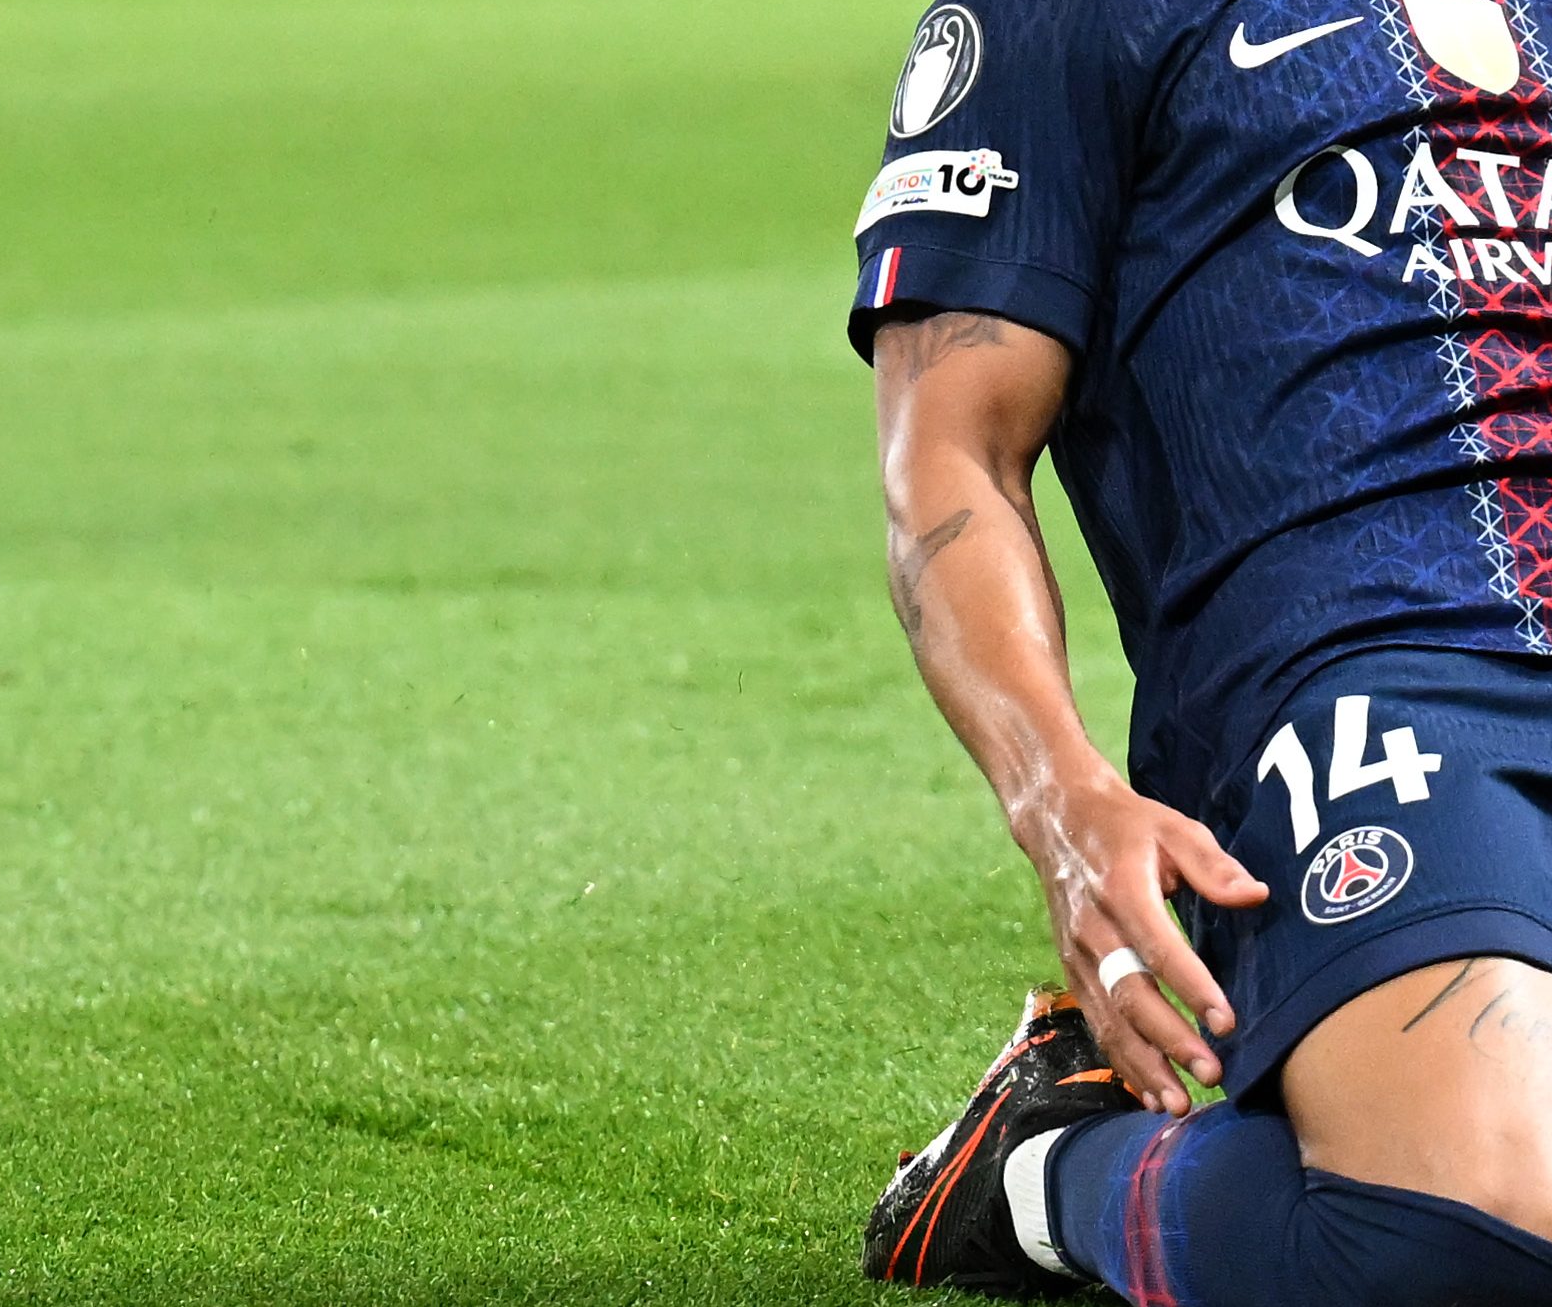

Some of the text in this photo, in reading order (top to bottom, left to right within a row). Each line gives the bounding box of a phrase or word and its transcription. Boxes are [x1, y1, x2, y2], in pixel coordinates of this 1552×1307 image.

[937, 164, 986, 196] 10
[1257, 695, 1442, 854] 14
[1311, 830, 1384, 873] PARIS
